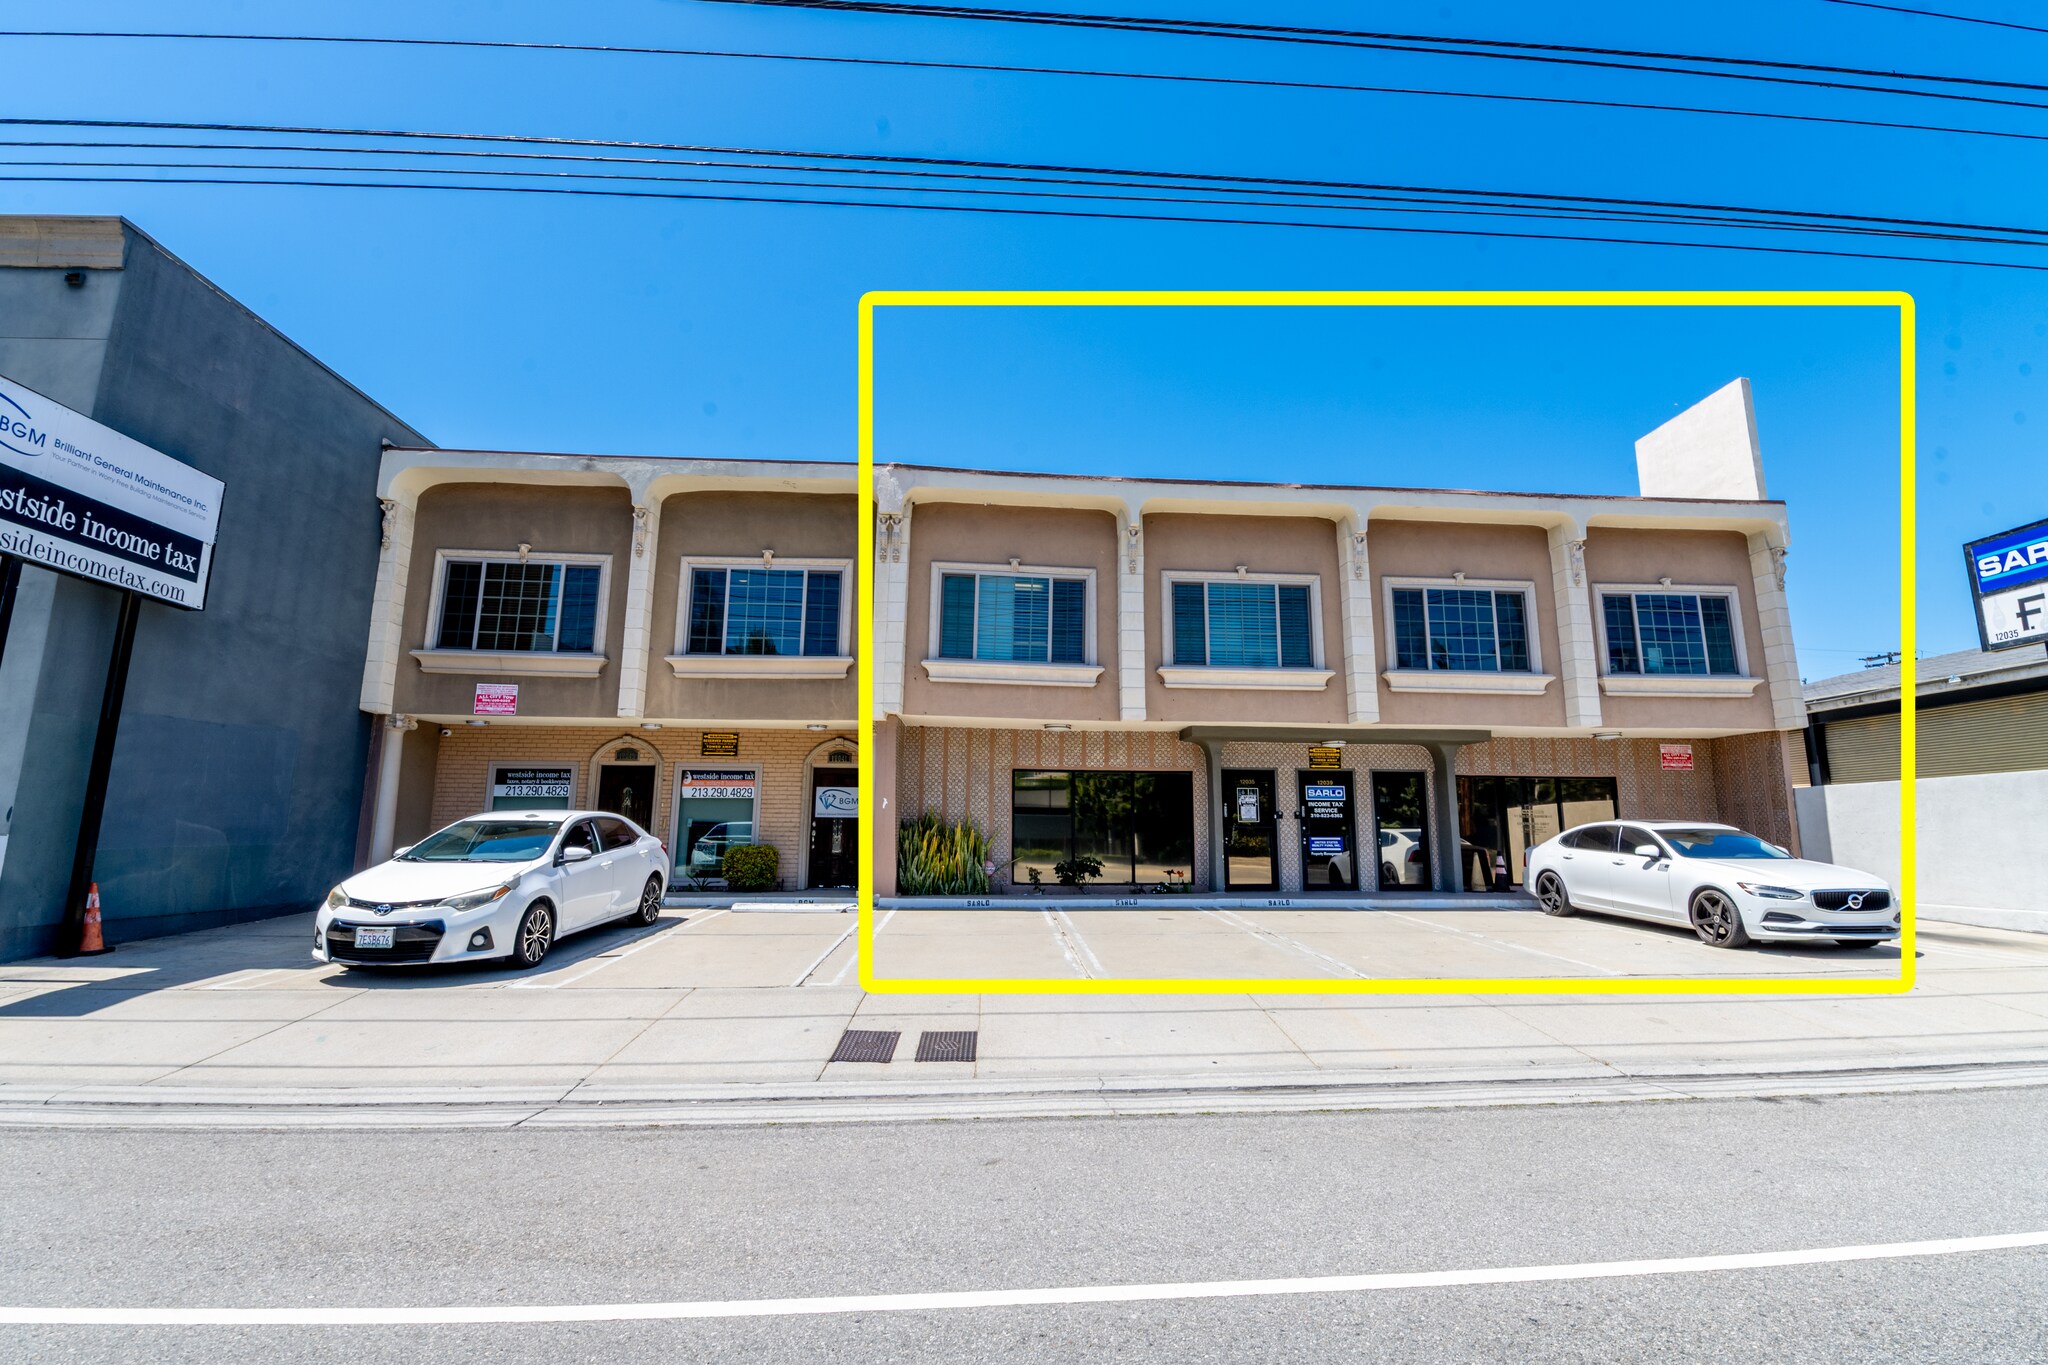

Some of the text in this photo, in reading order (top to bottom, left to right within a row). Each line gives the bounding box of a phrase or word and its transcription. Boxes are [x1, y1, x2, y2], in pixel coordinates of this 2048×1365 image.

[0, 415, 46, 448] BGM
[54, 438, 209, 513] Brilliant General Maintenance Inc.
[52, 452, 66, 462] Your
[67, 458, 91, 472] Partner
[91, 467, 97, 475] in
[98, 471, 116, 484] Worry
[116, 479, 129, 489] Free
[129, 485, 152, 500] Building
[152, 495, 188, 514] Maintenance
[80, 511, 161, 560] income
[165, 545, 198, 574] tax
[1995, 629, 2019, 641] 12035
[692, 772, 720, 780] westside
[505, 785, 569, 796] 213.290.4829
[691, 787, 753, 798] 213.290.4829
[1308, 789, 1343, 797] SARLO
[359, 935, 390, 945] 7ESB676
